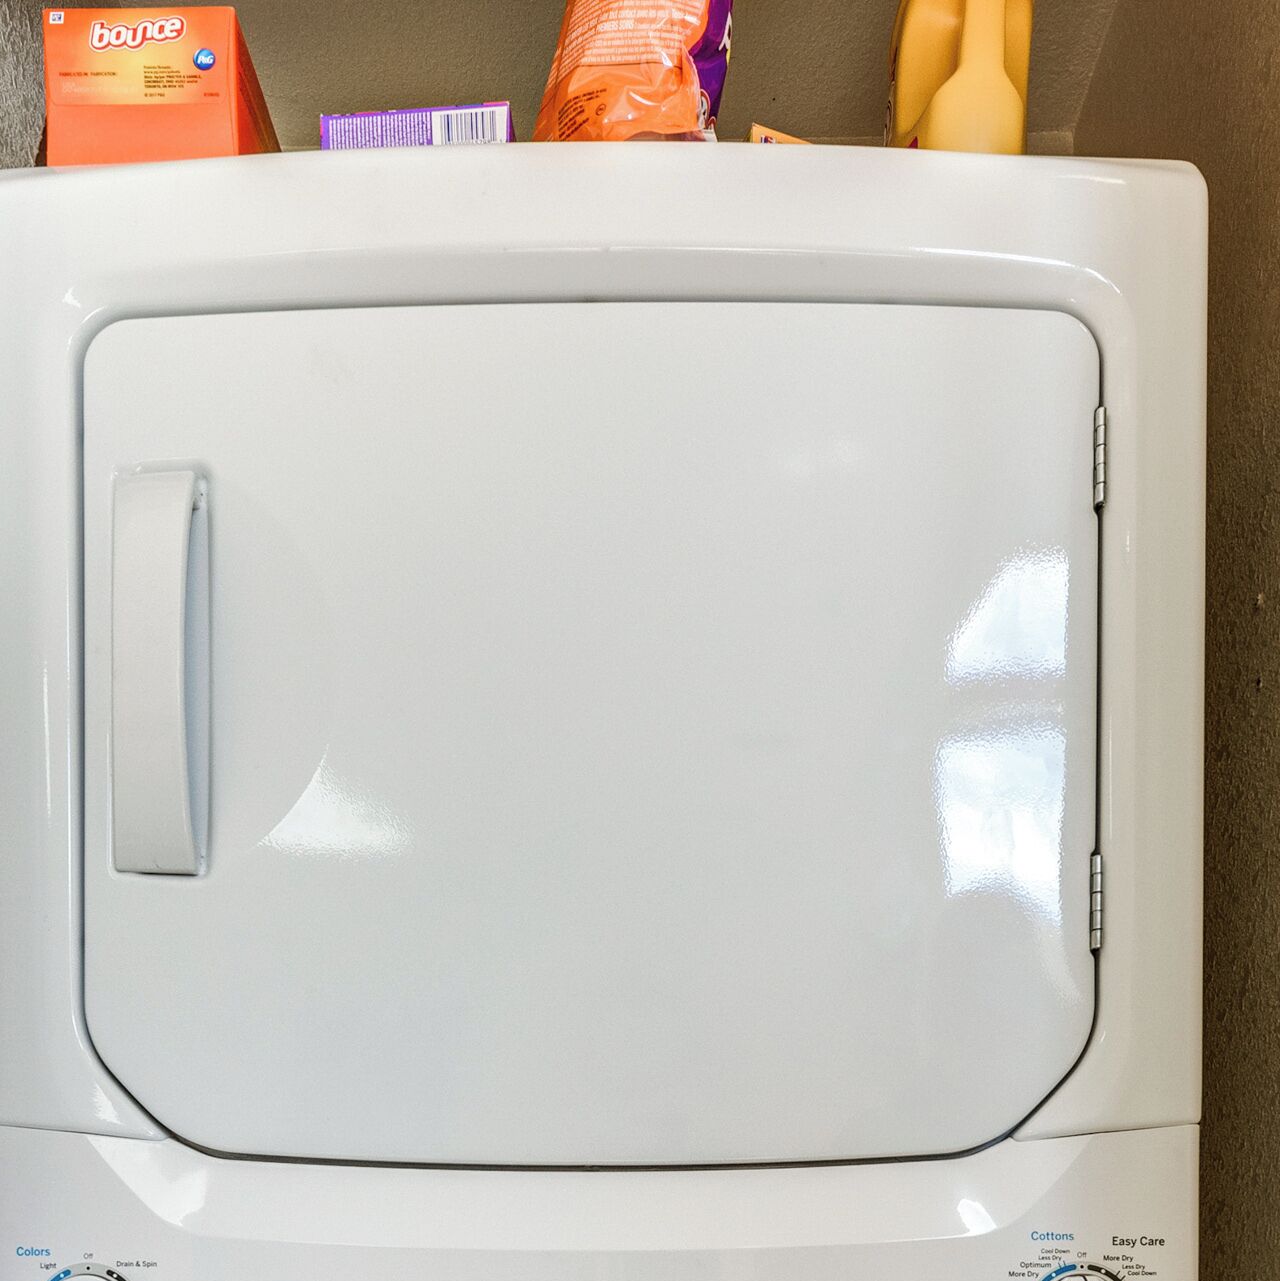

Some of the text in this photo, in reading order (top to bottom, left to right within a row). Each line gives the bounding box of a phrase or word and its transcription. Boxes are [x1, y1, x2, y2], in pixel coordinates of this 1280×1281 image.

[89, 16, 186, 52] bounce
[1031, 1231, 1074, 1241] Cottons
[1112, 1236, 1165, 1247] Easy Care
[16, 1246, 51, 1257] Colors
[83, 1253, 93, 1261] Off
[1121, 1255, 1134, 1263] Dry
[40, 1262, 57, 1271] Light
[116, 1260, 157, 1269] Drain & Spin
[1026, 1271, 1039, 1279] Dry
